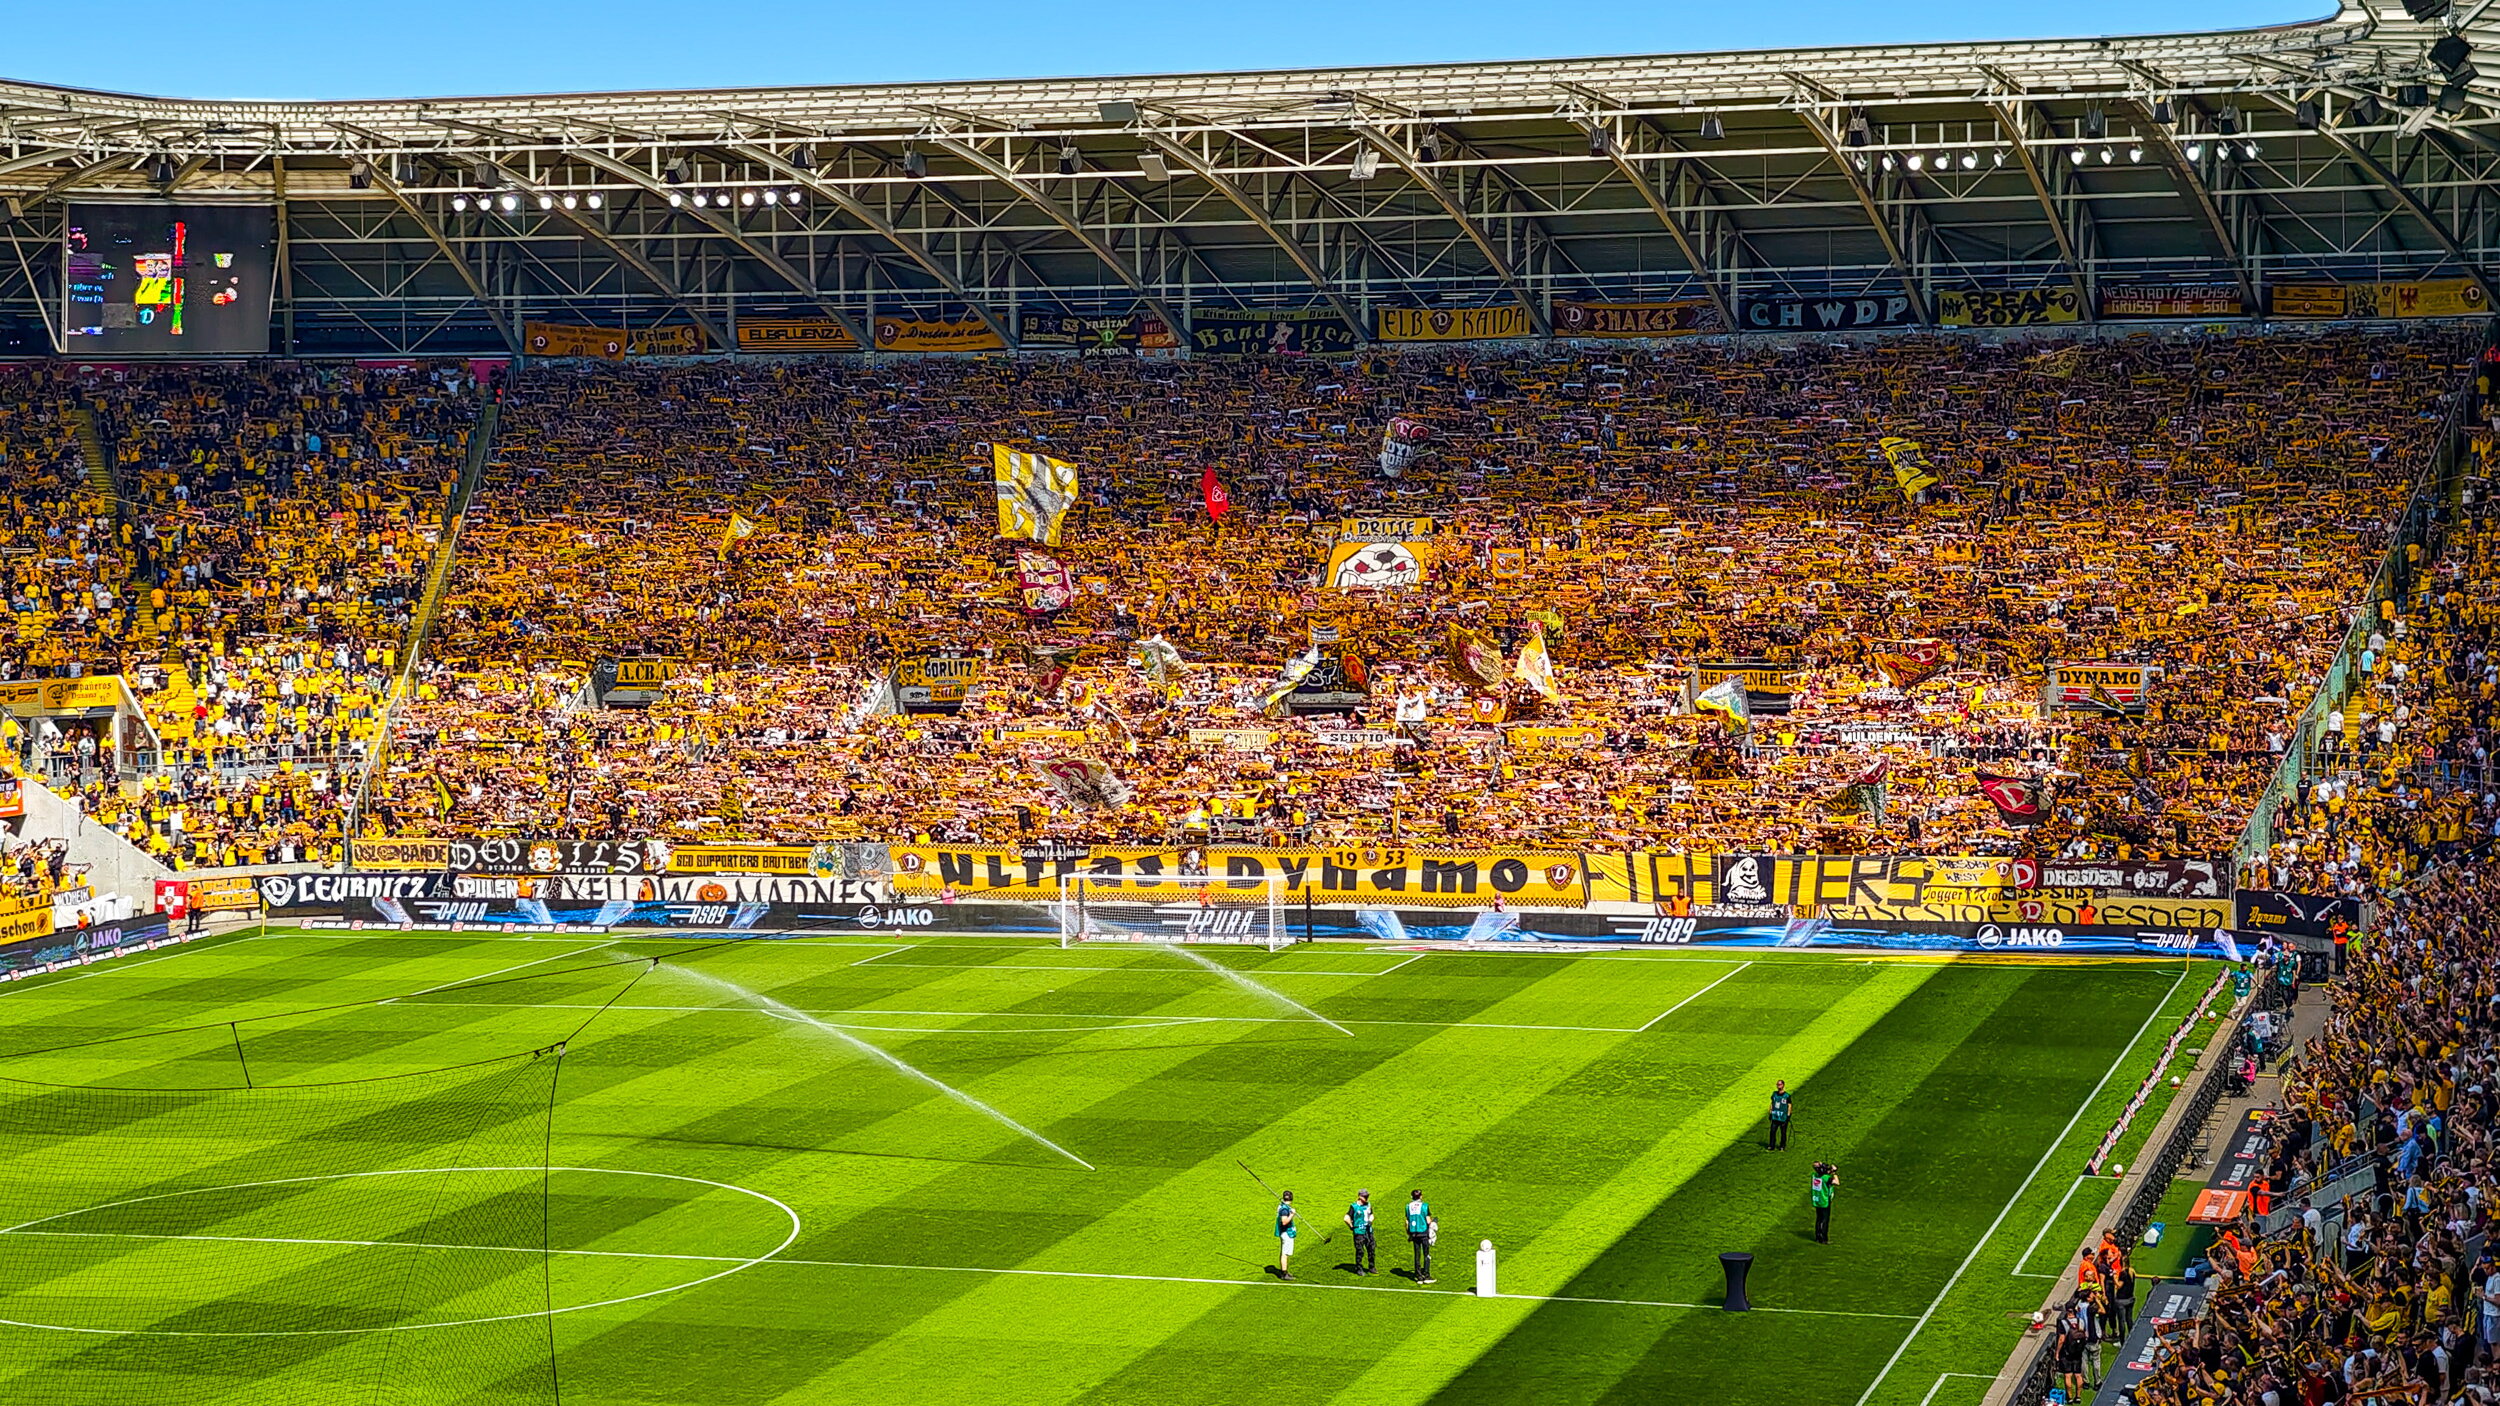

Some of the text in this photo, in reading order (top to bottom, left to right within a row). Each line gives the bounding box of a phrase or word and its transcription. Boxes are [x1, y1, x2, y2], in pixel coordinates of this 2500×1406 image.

[1962, 289, 2059, 311] FREAK
[2101, 286, 2241, 300] NEUSTADT/SACHSEN
[2171, 300, 2193, 313] DIE
[1085, 318, 1130, 329] FREITAL
[1384, 310, 1423, 337] ELB
[1462, 306, 1526, 337] KAIDA
[1594, 308, 1678, 331] SNAKES
[1102, 347, 1130, 357] TOUR
[1357, 520, 1416, 535] DRITTE
[2058, 671, 2141, 685] DYNAMO
[1330, 732, 1394, 743] SEKTION
[1841, 730, 1917, 745] MULDENTAL
[697, 854, 759, 868] SUPPORTERS
[1336, 851, 1358, 866] 19
[1384, 850, 1405, 864] 53
[463, 878, 548, 899] PULSNZ
[736, 878, 878, 902] MADNES
[688, 905, 729, 925] RS89
[885, 908, 933, 925] JAKO
[2051, 900, 2224, 928] DESDEN
[0, 917, 36, 939] schen
[1641, 917, 1697, 943] RS89
[90, 928, 122, 949] JAKO
[2007, 929, 2064, 946] JAKO
